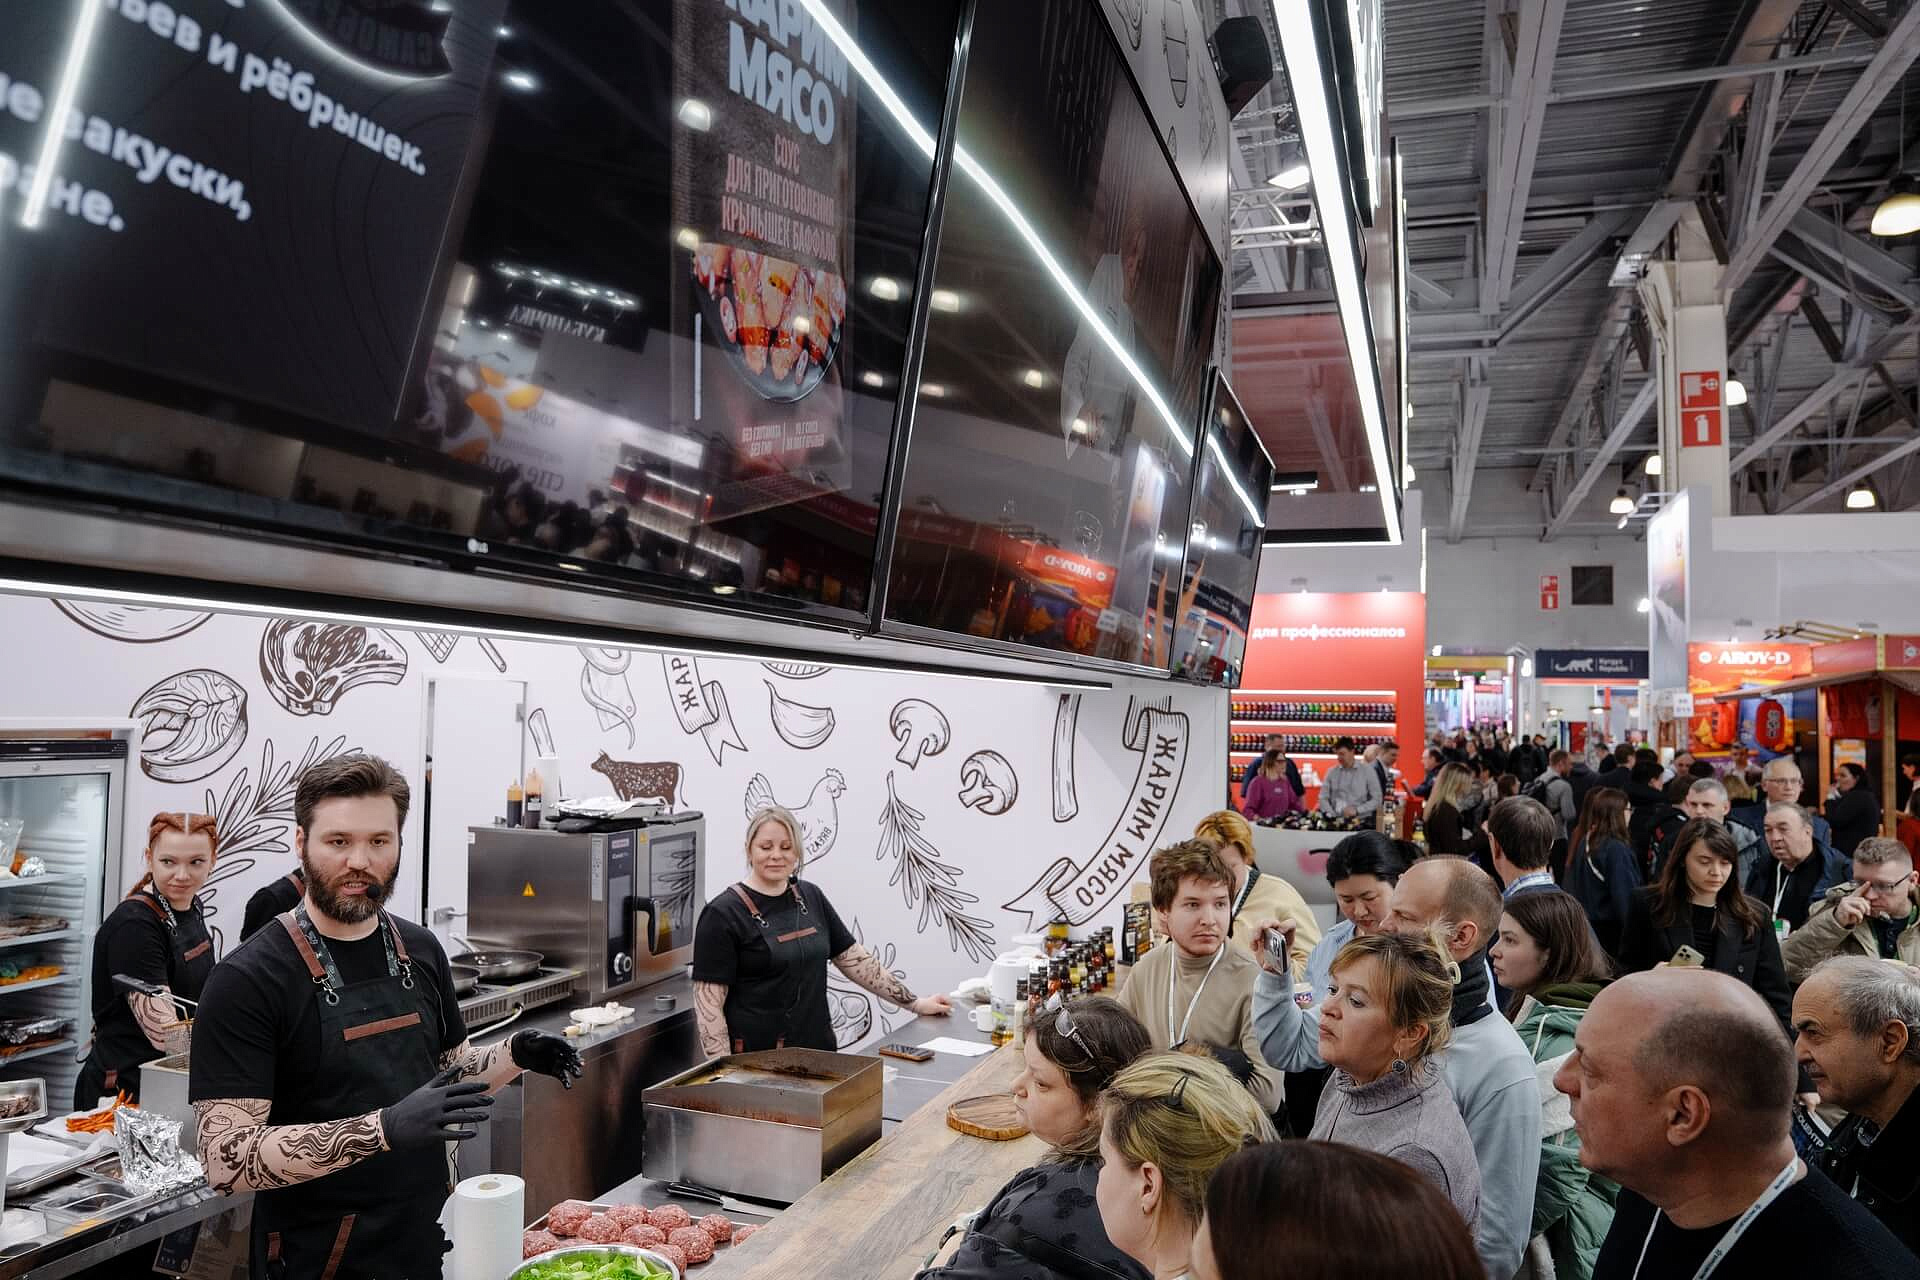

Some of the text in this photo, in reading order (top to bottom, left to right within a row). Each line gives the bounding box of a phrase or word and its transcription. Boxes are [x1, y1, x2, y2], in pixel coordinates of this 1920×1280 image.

[724, 0, 848, 98] АРИМ
[208, 33, 238, 73] и
[240, 52, 426, 176] рёбрышек.
[729, 20, 834, 145] МЯСО
[725, 152, 751, 195] ДЛЯ
[774, 133, 801, 176] СОУС
[1252, 623, 1406, 641] для профессионалов
[1718, 650, 1791, 666] AROY-D
[671, 657, 700, 713] ЖАР
[1075, 733, 1178, 907] ЖАРИМ МЯСО
